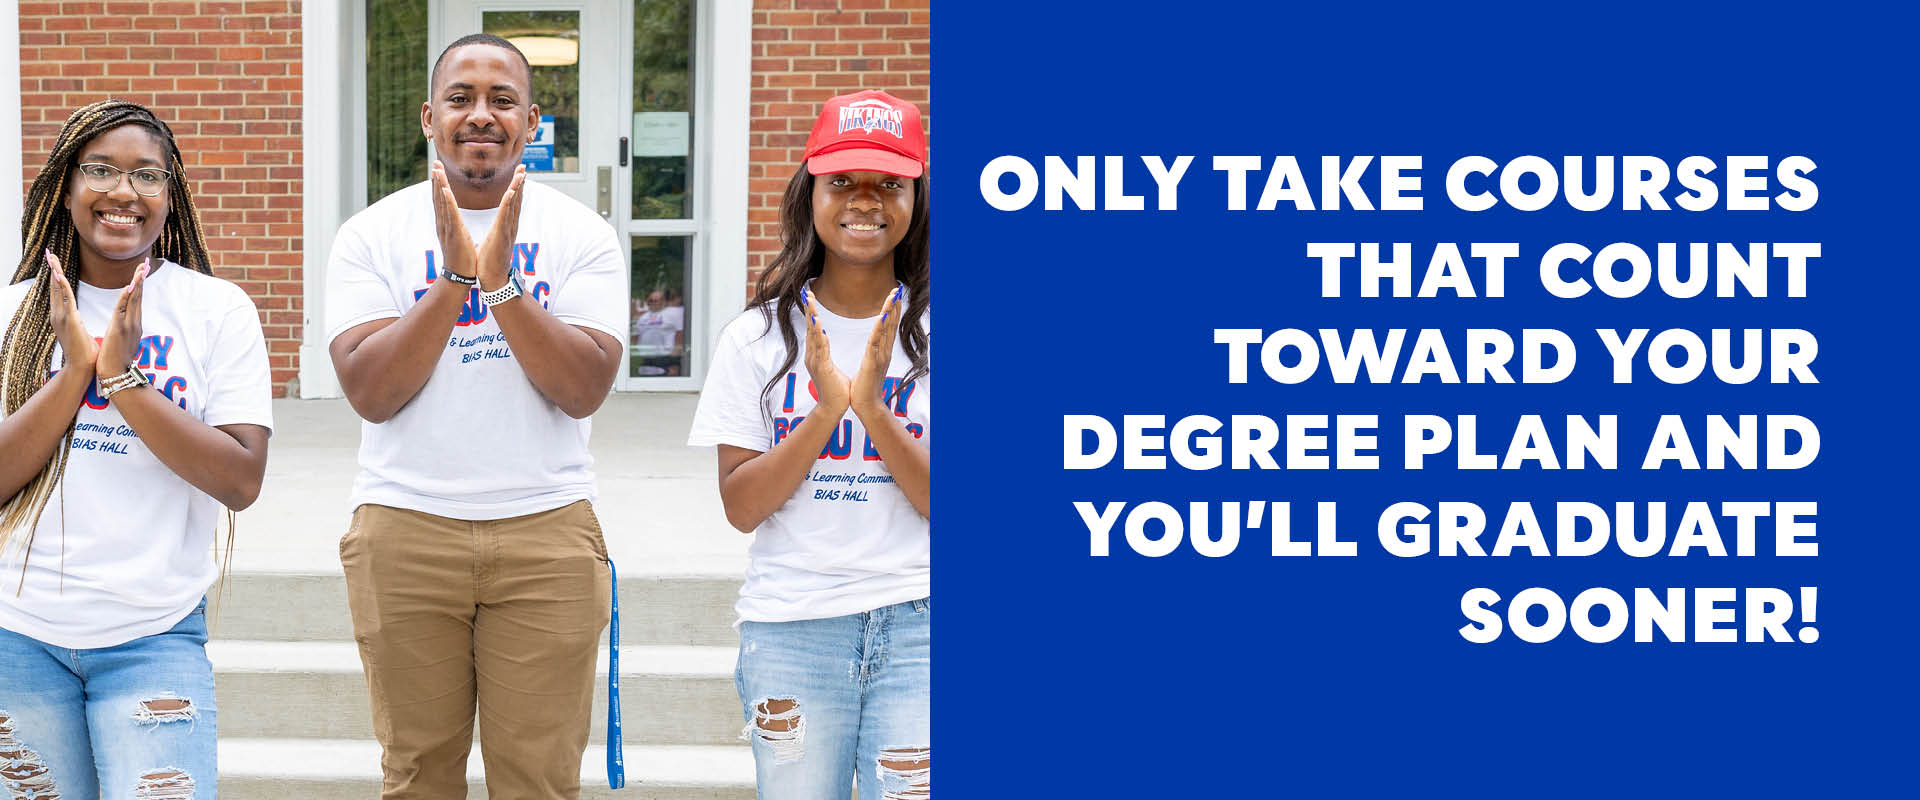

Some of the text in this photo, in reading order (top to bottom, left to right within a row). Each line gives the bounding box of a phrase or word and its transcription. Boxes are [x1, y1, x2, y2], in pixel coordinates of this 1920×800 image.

[839, 106, 903, 138] VIKINGS
[449, 337, 457, 346] &
[459, 333, 494, 347] Learning
[484, 347, 510, 359] HALL
[74, 423, 115, 437] earning
[72, 438, 128, 455] BIAS HALL
[813, 471, 856, 486] Learning
[814, 489, 868, 501] BIAS HALL
